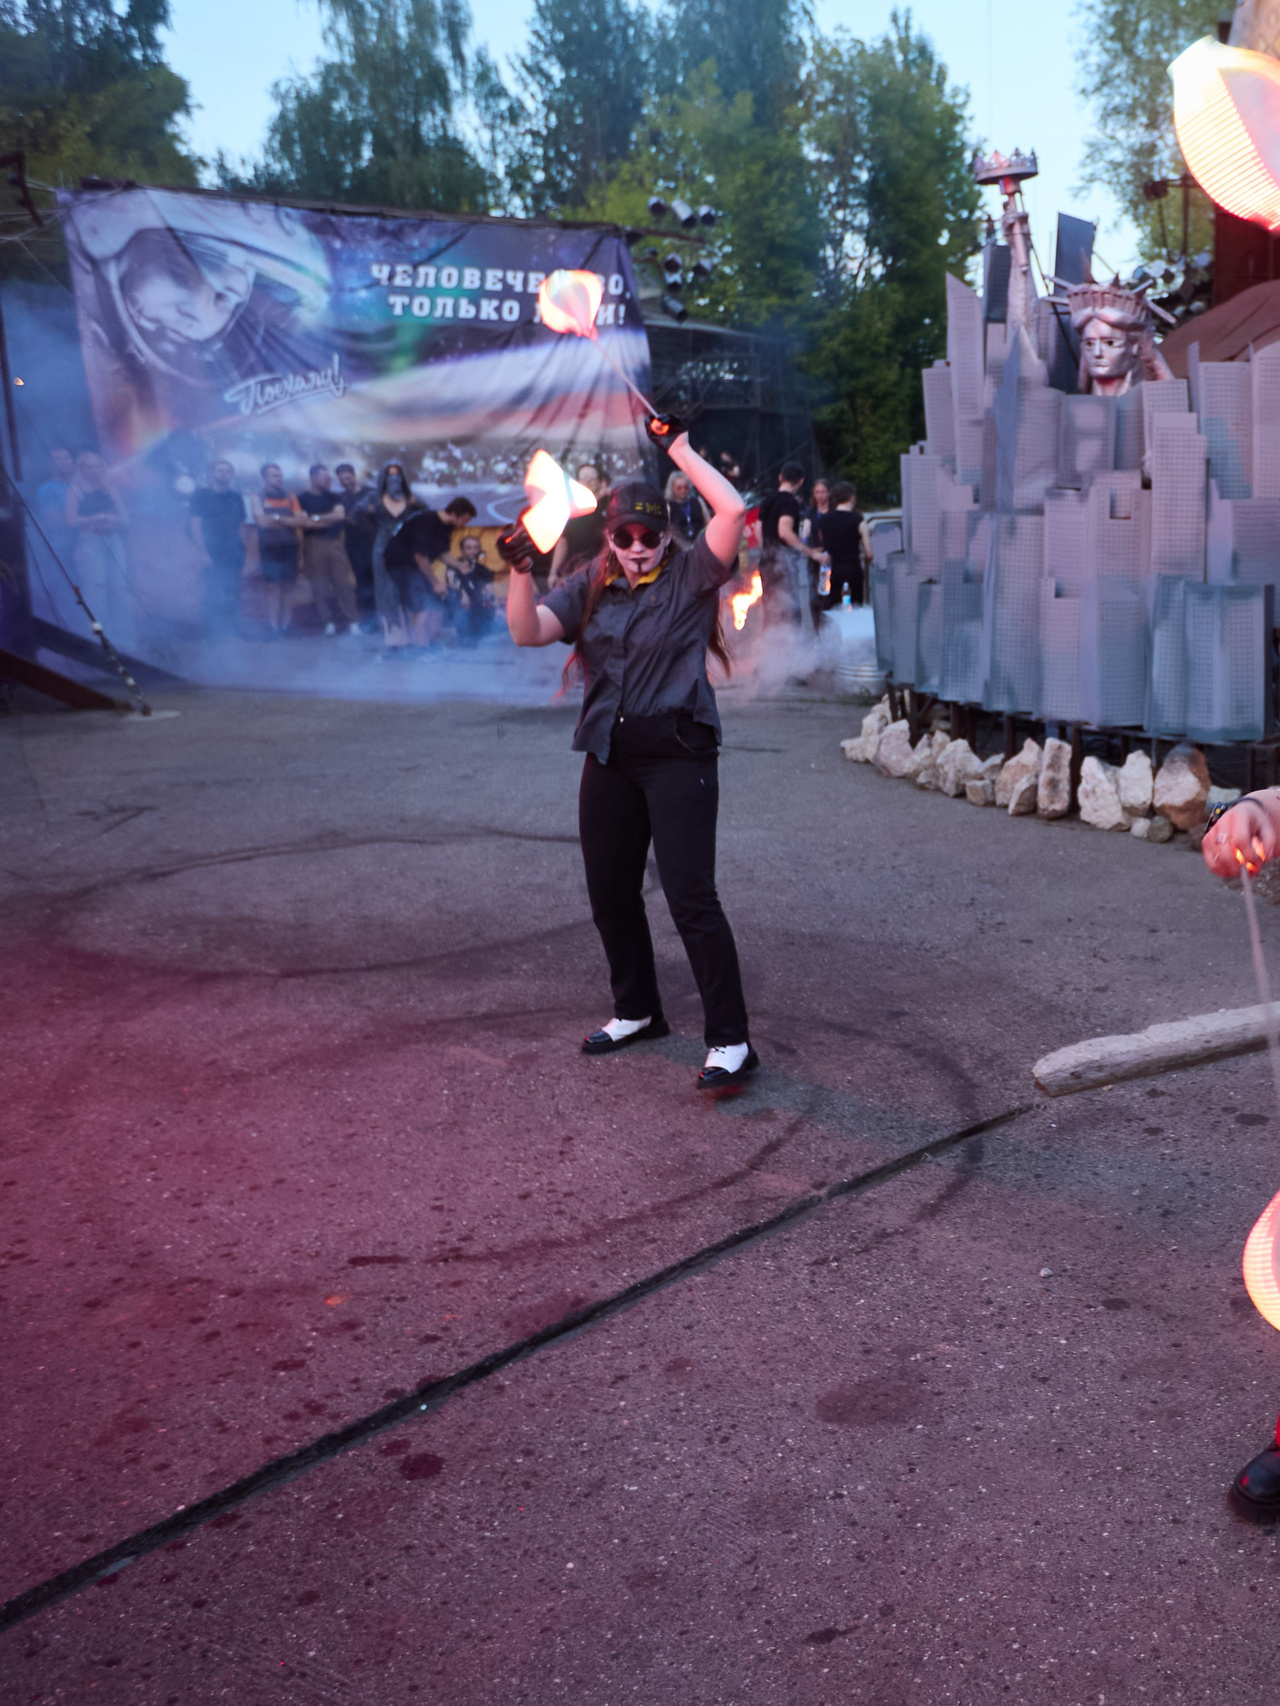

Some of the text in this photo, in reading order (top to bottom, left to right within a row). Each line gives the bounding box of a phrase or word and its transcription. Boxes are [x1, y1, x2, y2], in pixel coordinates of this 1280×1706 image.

[370, 263, 631, 299] ЧЕЛОВЕЧЕО,
[388, 294, 520, 322] ТОЛЬКО
[223, 352, 344, 416] Поехали!
